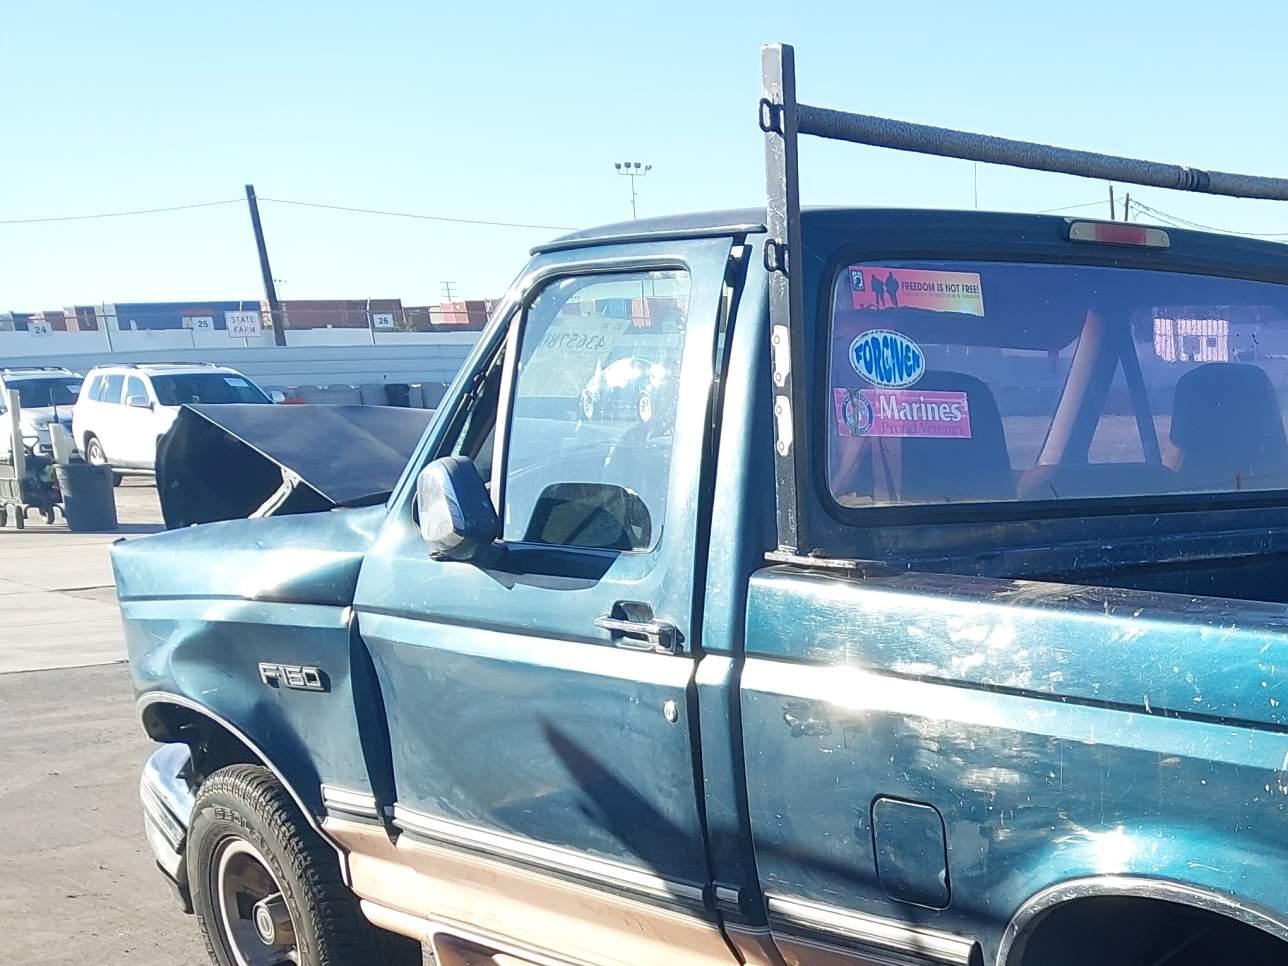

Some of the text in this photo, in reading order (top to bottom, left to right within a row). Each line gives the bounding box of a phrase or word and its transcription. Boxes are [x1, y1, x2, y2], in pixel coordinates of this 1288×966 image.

[901, 281, 935, 292] FREEDOM
[936, 283, 944, 292] IS
[945, 283, 960, 293] NOT
[198, 319, 209, 329] 25
[231, 315, 255, 323] STATE
[378, 317, 389, 325] 26
[33, 326, 47, 334] 24
[855, 335, 920, 383] FORGIVEN
[880, 395, 961, 421] Marines
